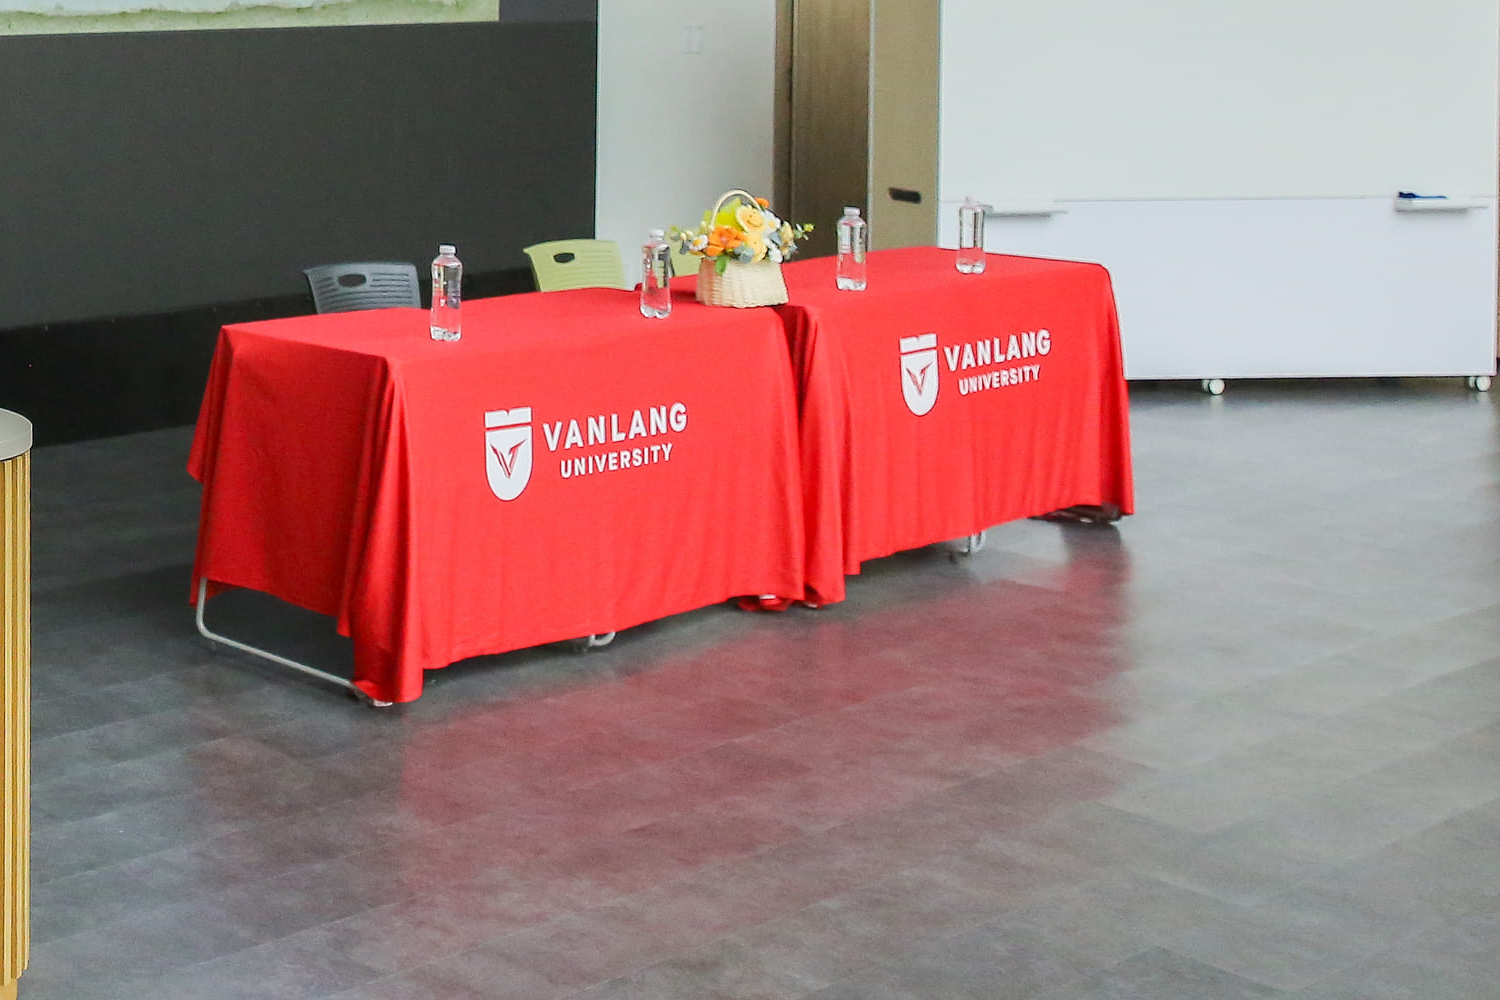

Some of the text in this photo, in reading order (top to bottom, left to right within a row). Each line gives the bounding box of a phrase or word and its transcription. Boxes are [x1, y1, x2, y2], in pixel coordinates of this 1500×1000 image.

[942, 328, 1052, 372] VANLANG
[958, 364, 1041, 396] UNIVERSITY
[542, 401, 688, 452] VANLANG
[560, 441, 674, 479] UNIVERSITY
